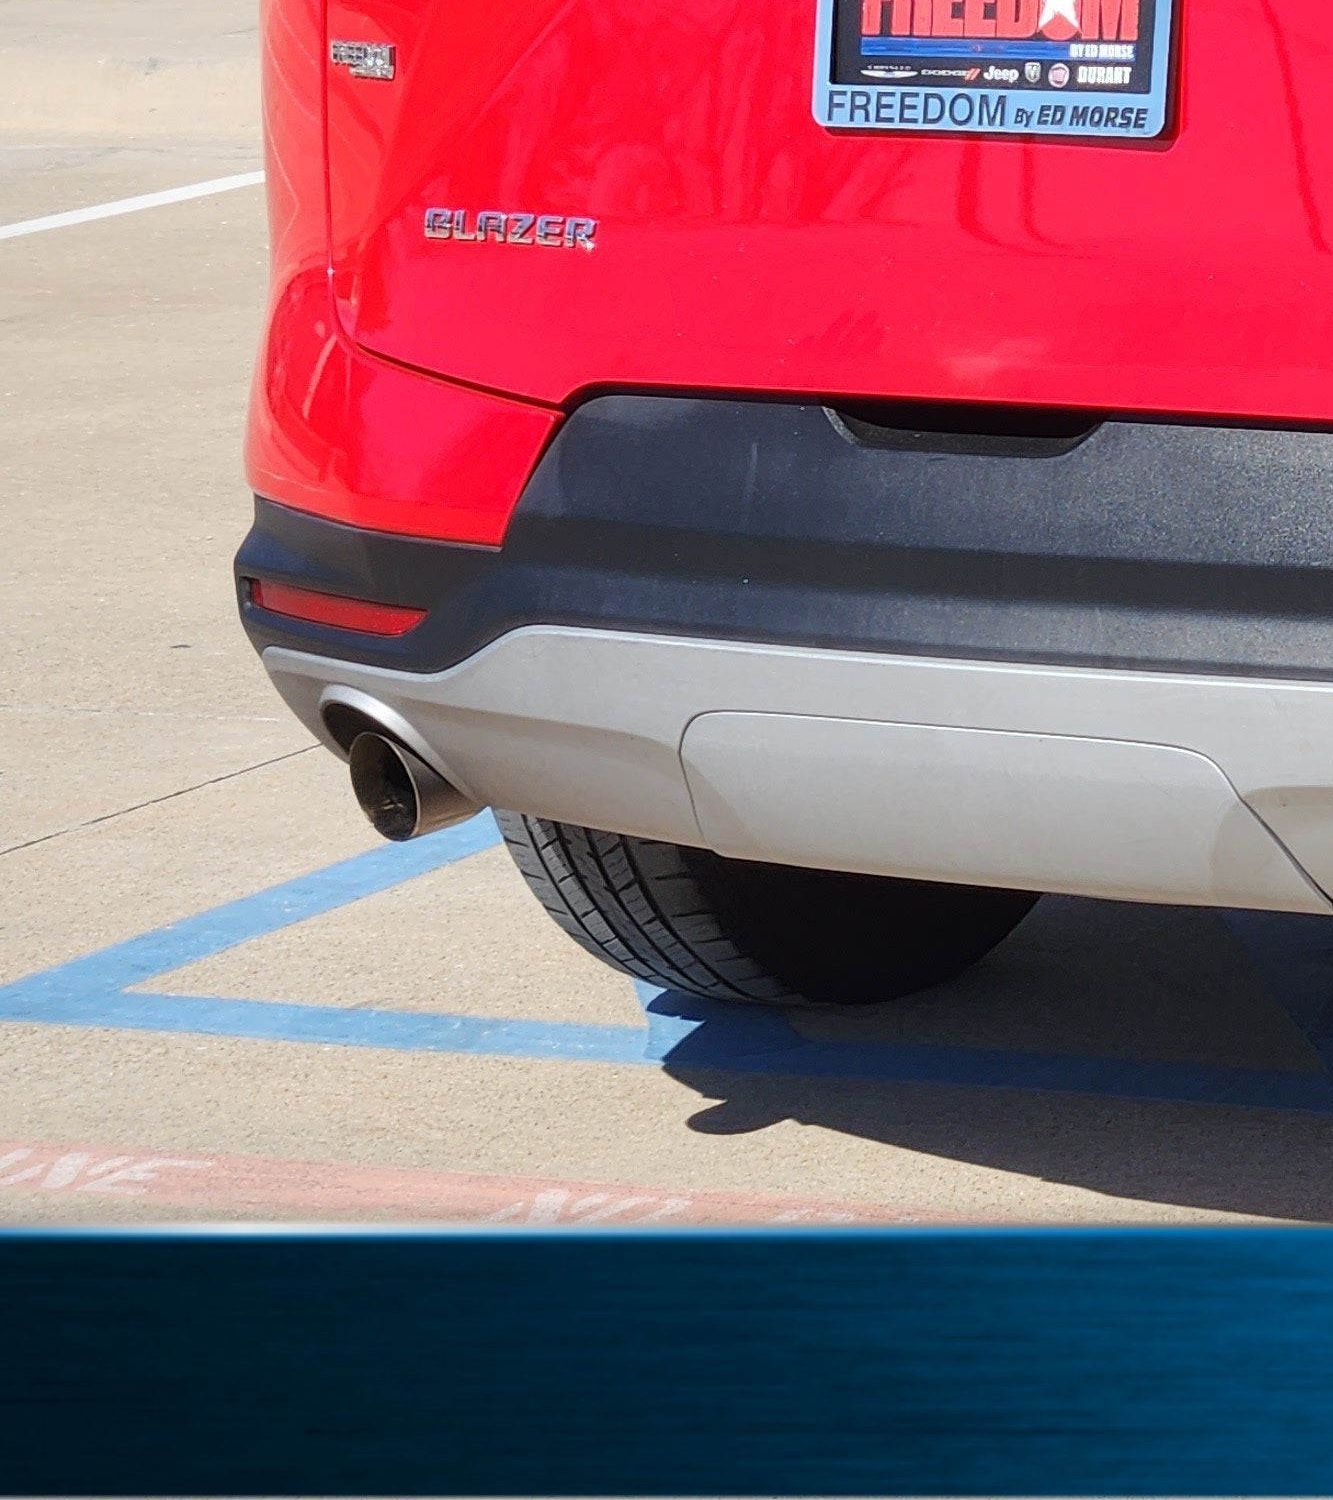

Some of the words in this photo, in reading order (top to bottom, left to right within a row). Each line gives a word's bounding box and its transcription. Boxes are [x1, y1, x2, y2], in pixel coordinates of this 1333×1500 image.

[1099, 44, 1135, 59] MORSE
[983, 64, 1020, 84] Jeep
[1077, 65, 1133, 85] DURANT
[827, 90, 1008, 128] FREEDOM
[1037, 105, 1065, 127] ED
[1069, 105, 1149, 130] MORSE
[425, 207, 597, 251] BLAZER
